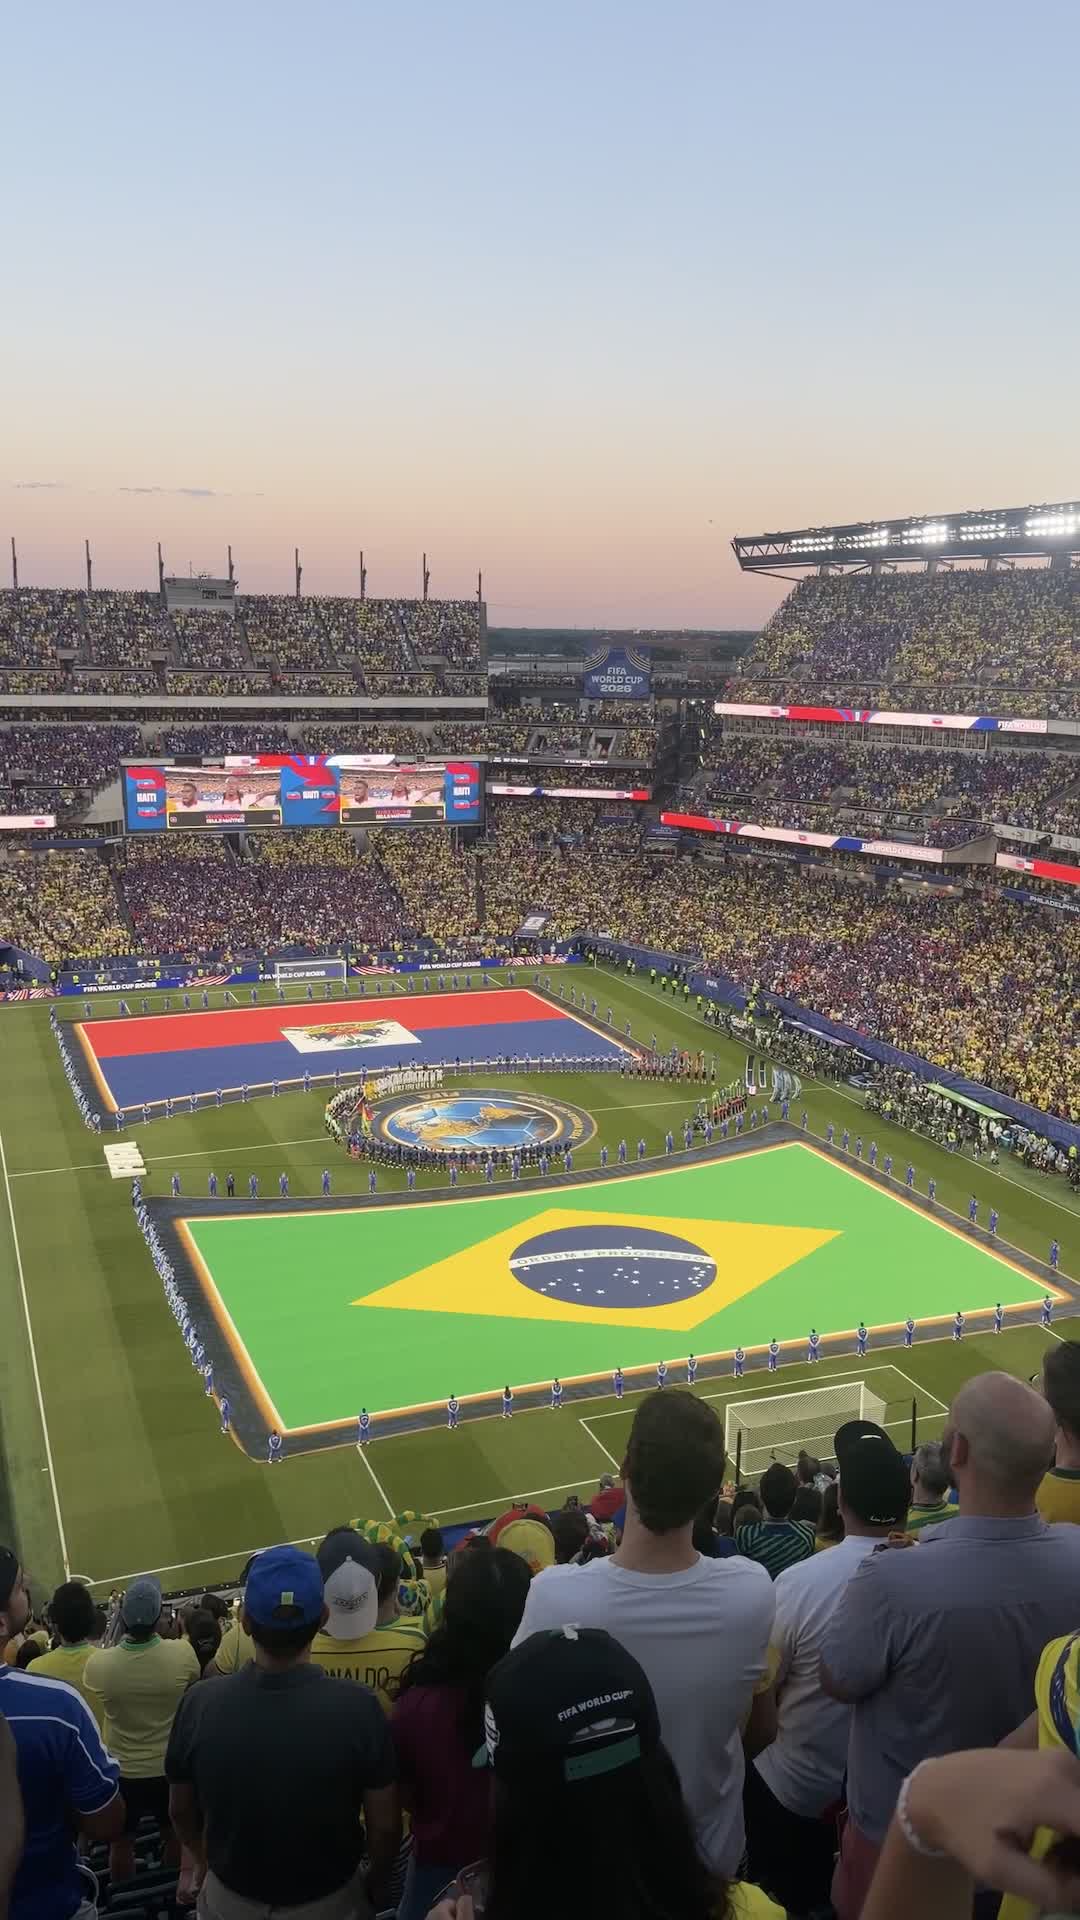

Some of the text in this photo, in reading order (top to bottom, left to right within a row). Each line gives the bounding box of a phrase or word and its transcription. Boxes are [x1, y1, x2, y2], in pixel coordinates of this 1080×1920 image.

[607, 667, 627, 675] FIFA
[591, 675, 644, 684] WORLD CUP
[600, 684, 632, 693] 2026
[136, 792, 157, 803] HAITI
[1029, 895, 1080, 912] PHILADELPHIA
[325, 1666, 389, 1690] NALDO
[557, 1705, 579, 1721] FIFA
[578, 1694, 612, 1711] WORLD
